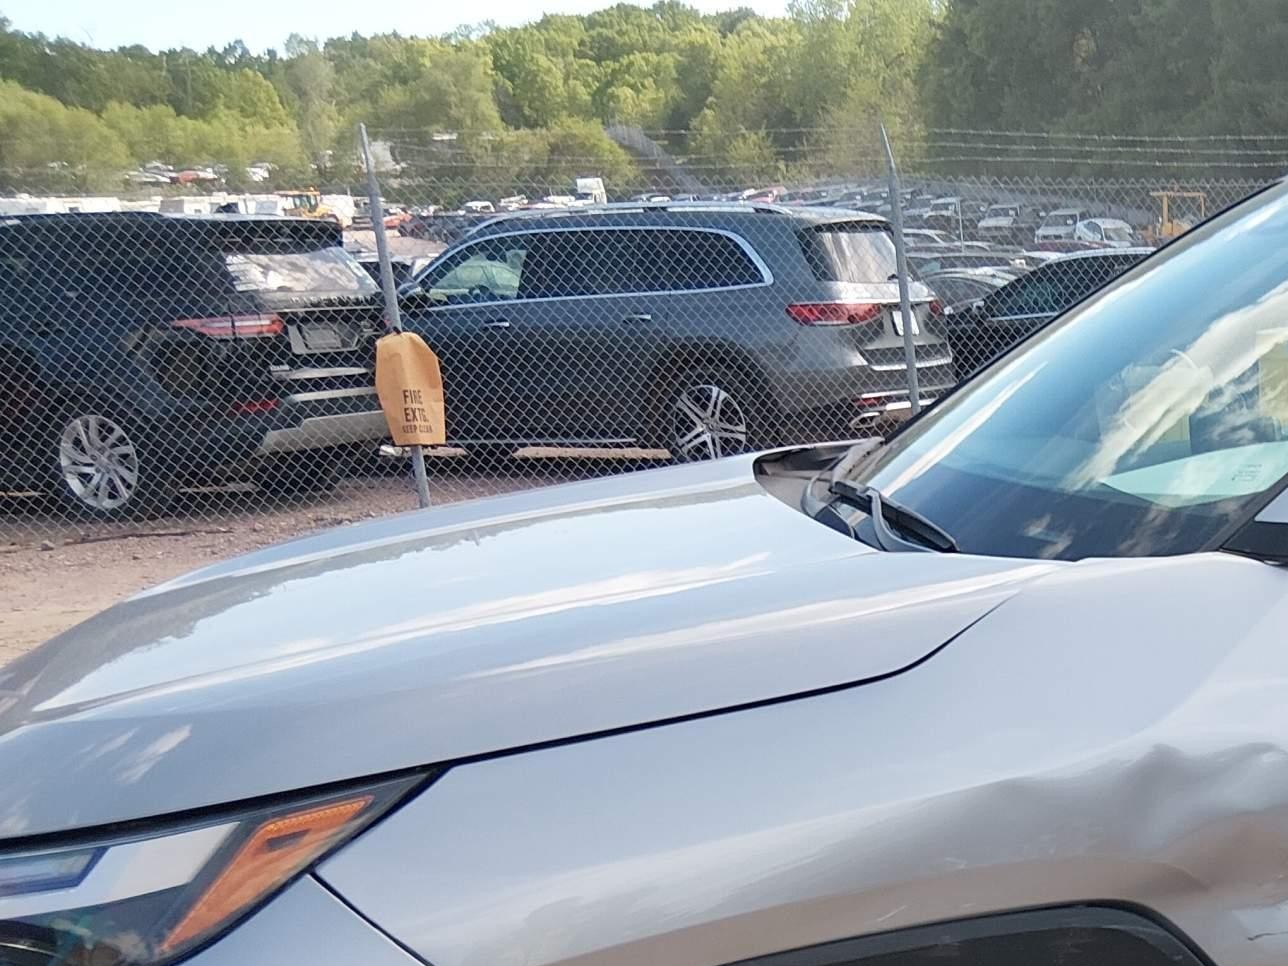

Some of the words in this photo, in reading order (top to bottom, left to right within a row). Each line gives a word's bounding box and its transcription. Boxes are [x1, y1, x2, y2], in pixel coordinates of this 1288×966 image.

[402, 389, 423, 405] FIRE
[404, 408, 430, 422] EXTG.
[402, 424, 417, 433] KEEP
